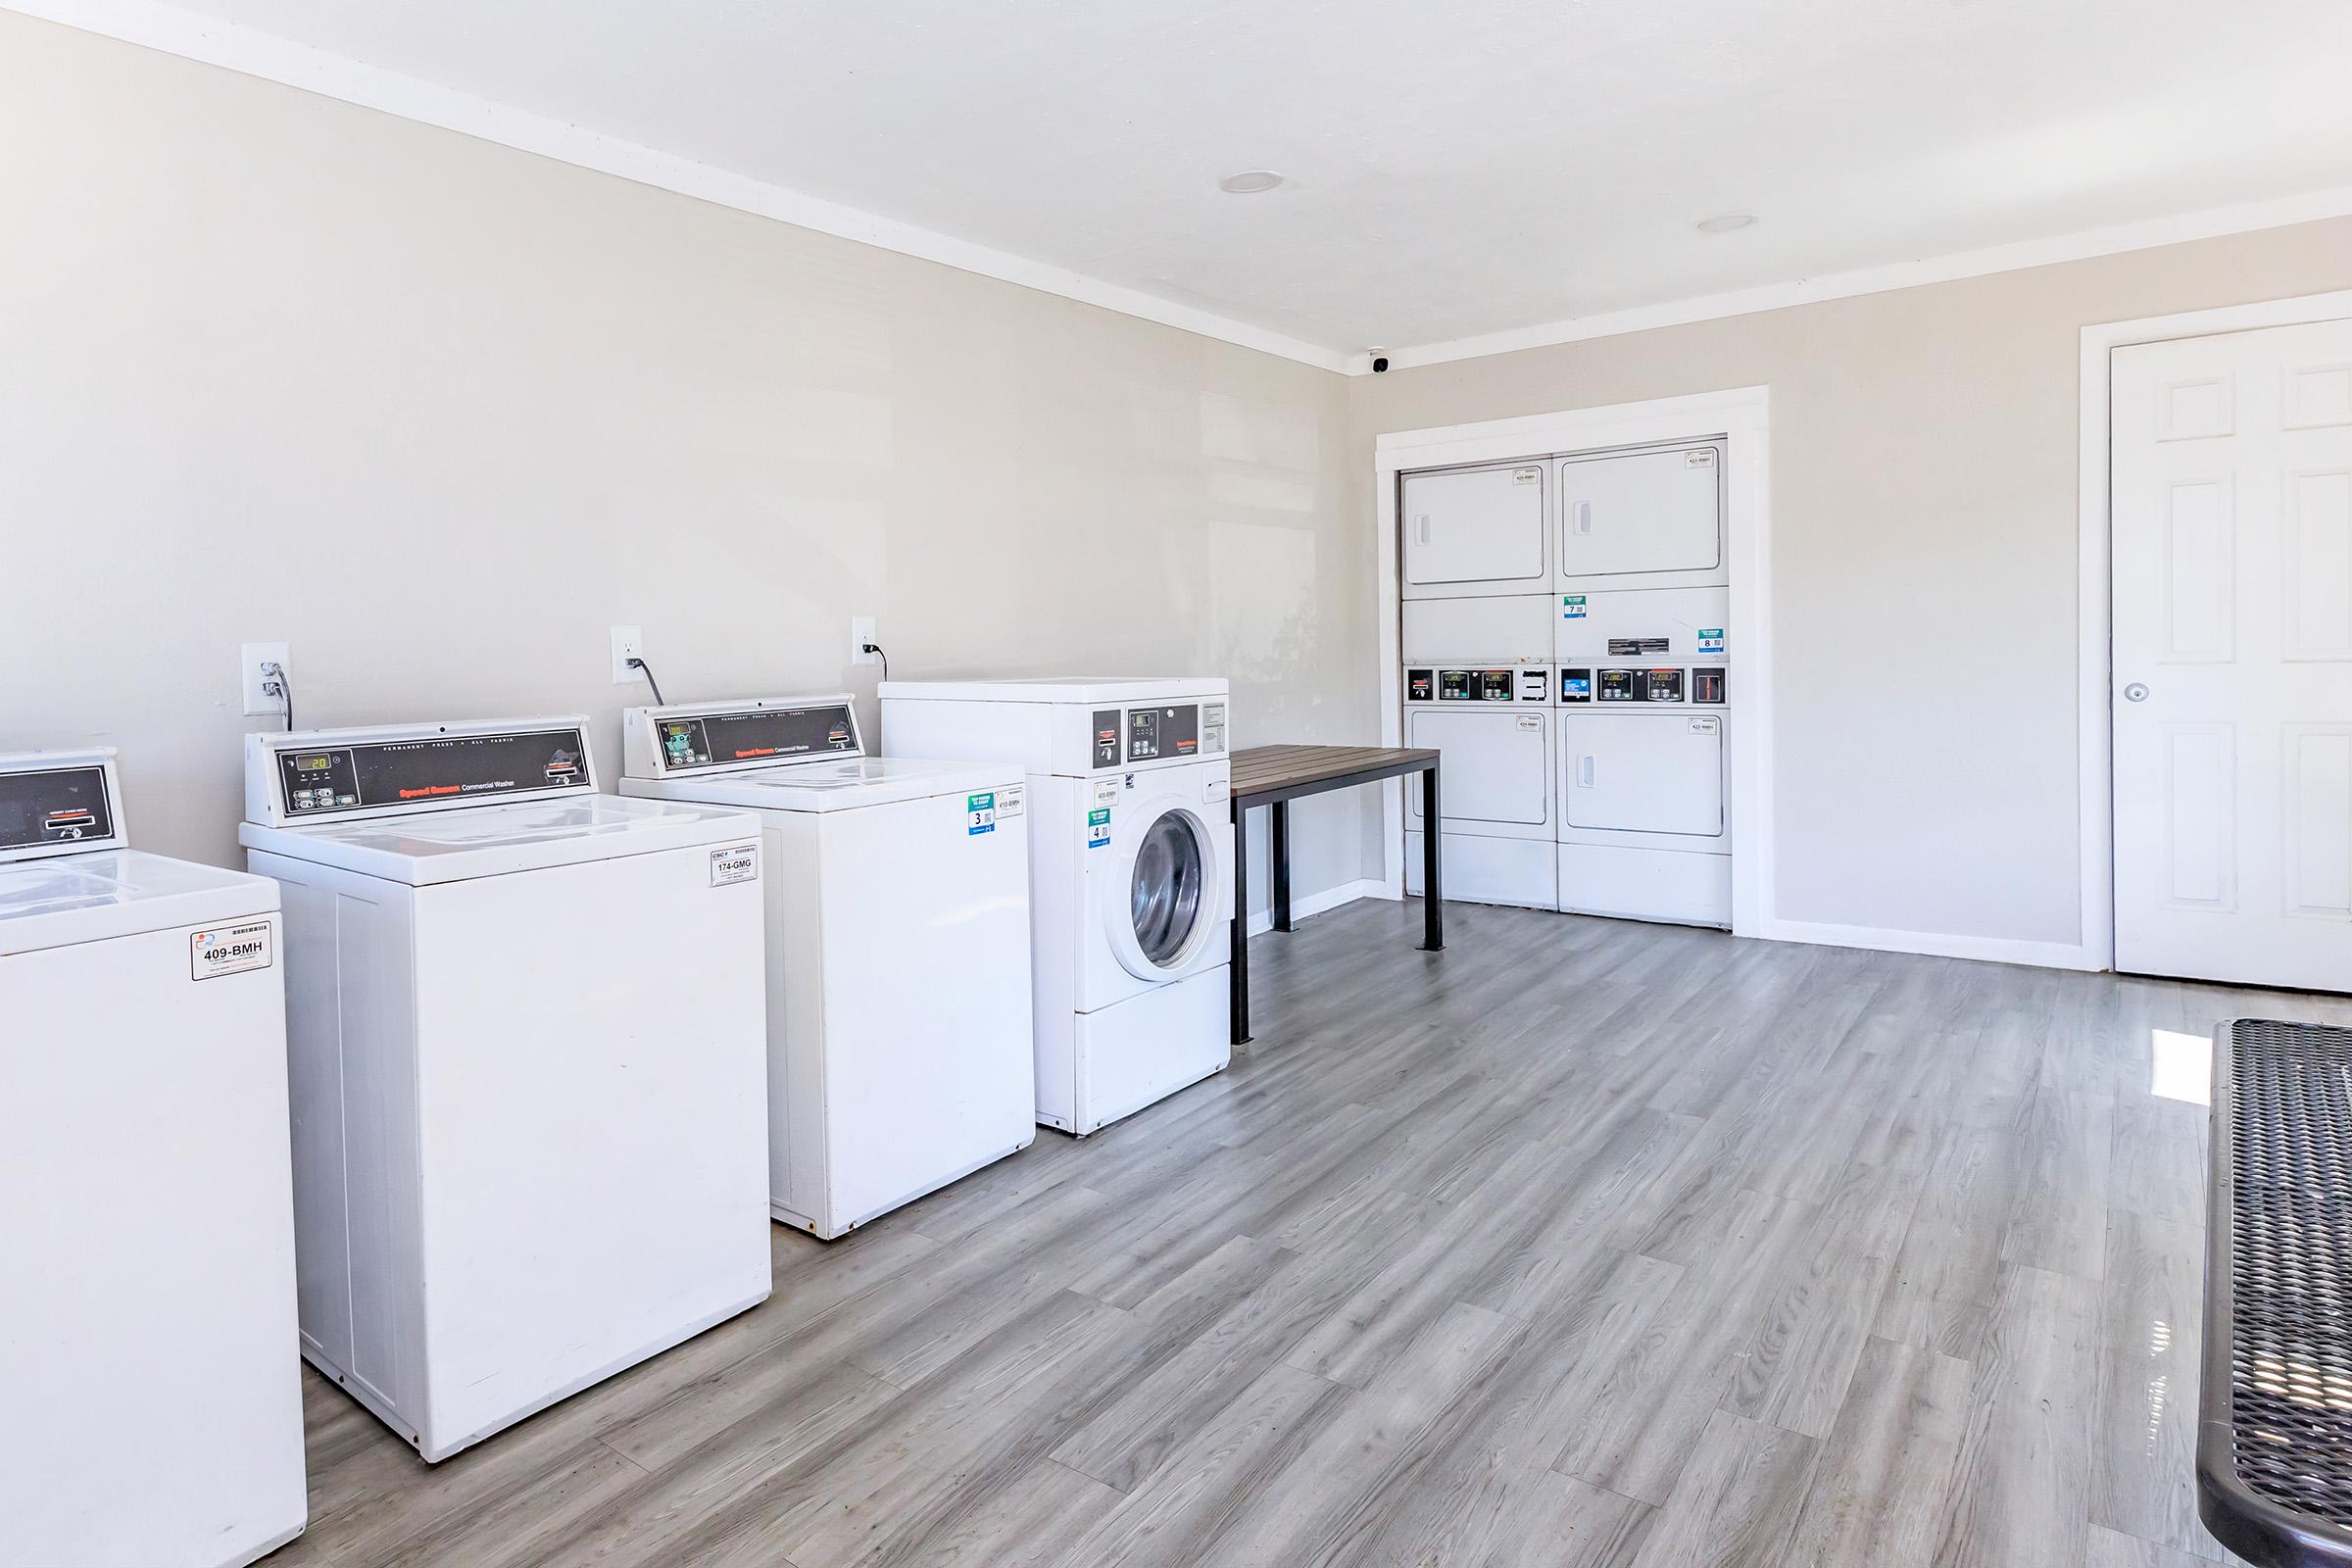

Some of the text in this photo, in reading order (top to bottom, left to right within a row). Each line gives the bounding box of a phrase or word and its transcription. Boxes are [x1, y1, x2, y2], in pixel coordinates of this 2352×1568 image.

[1704, 639, 1711, 648] 8
[735, 749, 755, 758] Speed
[312, 758, 326, 769] 20
[399, 780, 514, 798] Speed Queen Commercial Washer
[974, 812, 982, 825] 3
[1094, 826, 1100, 838] 4
[718, 858, 752, 871] 174-GMG
[204, 941, 263, 960] 409-BMH
